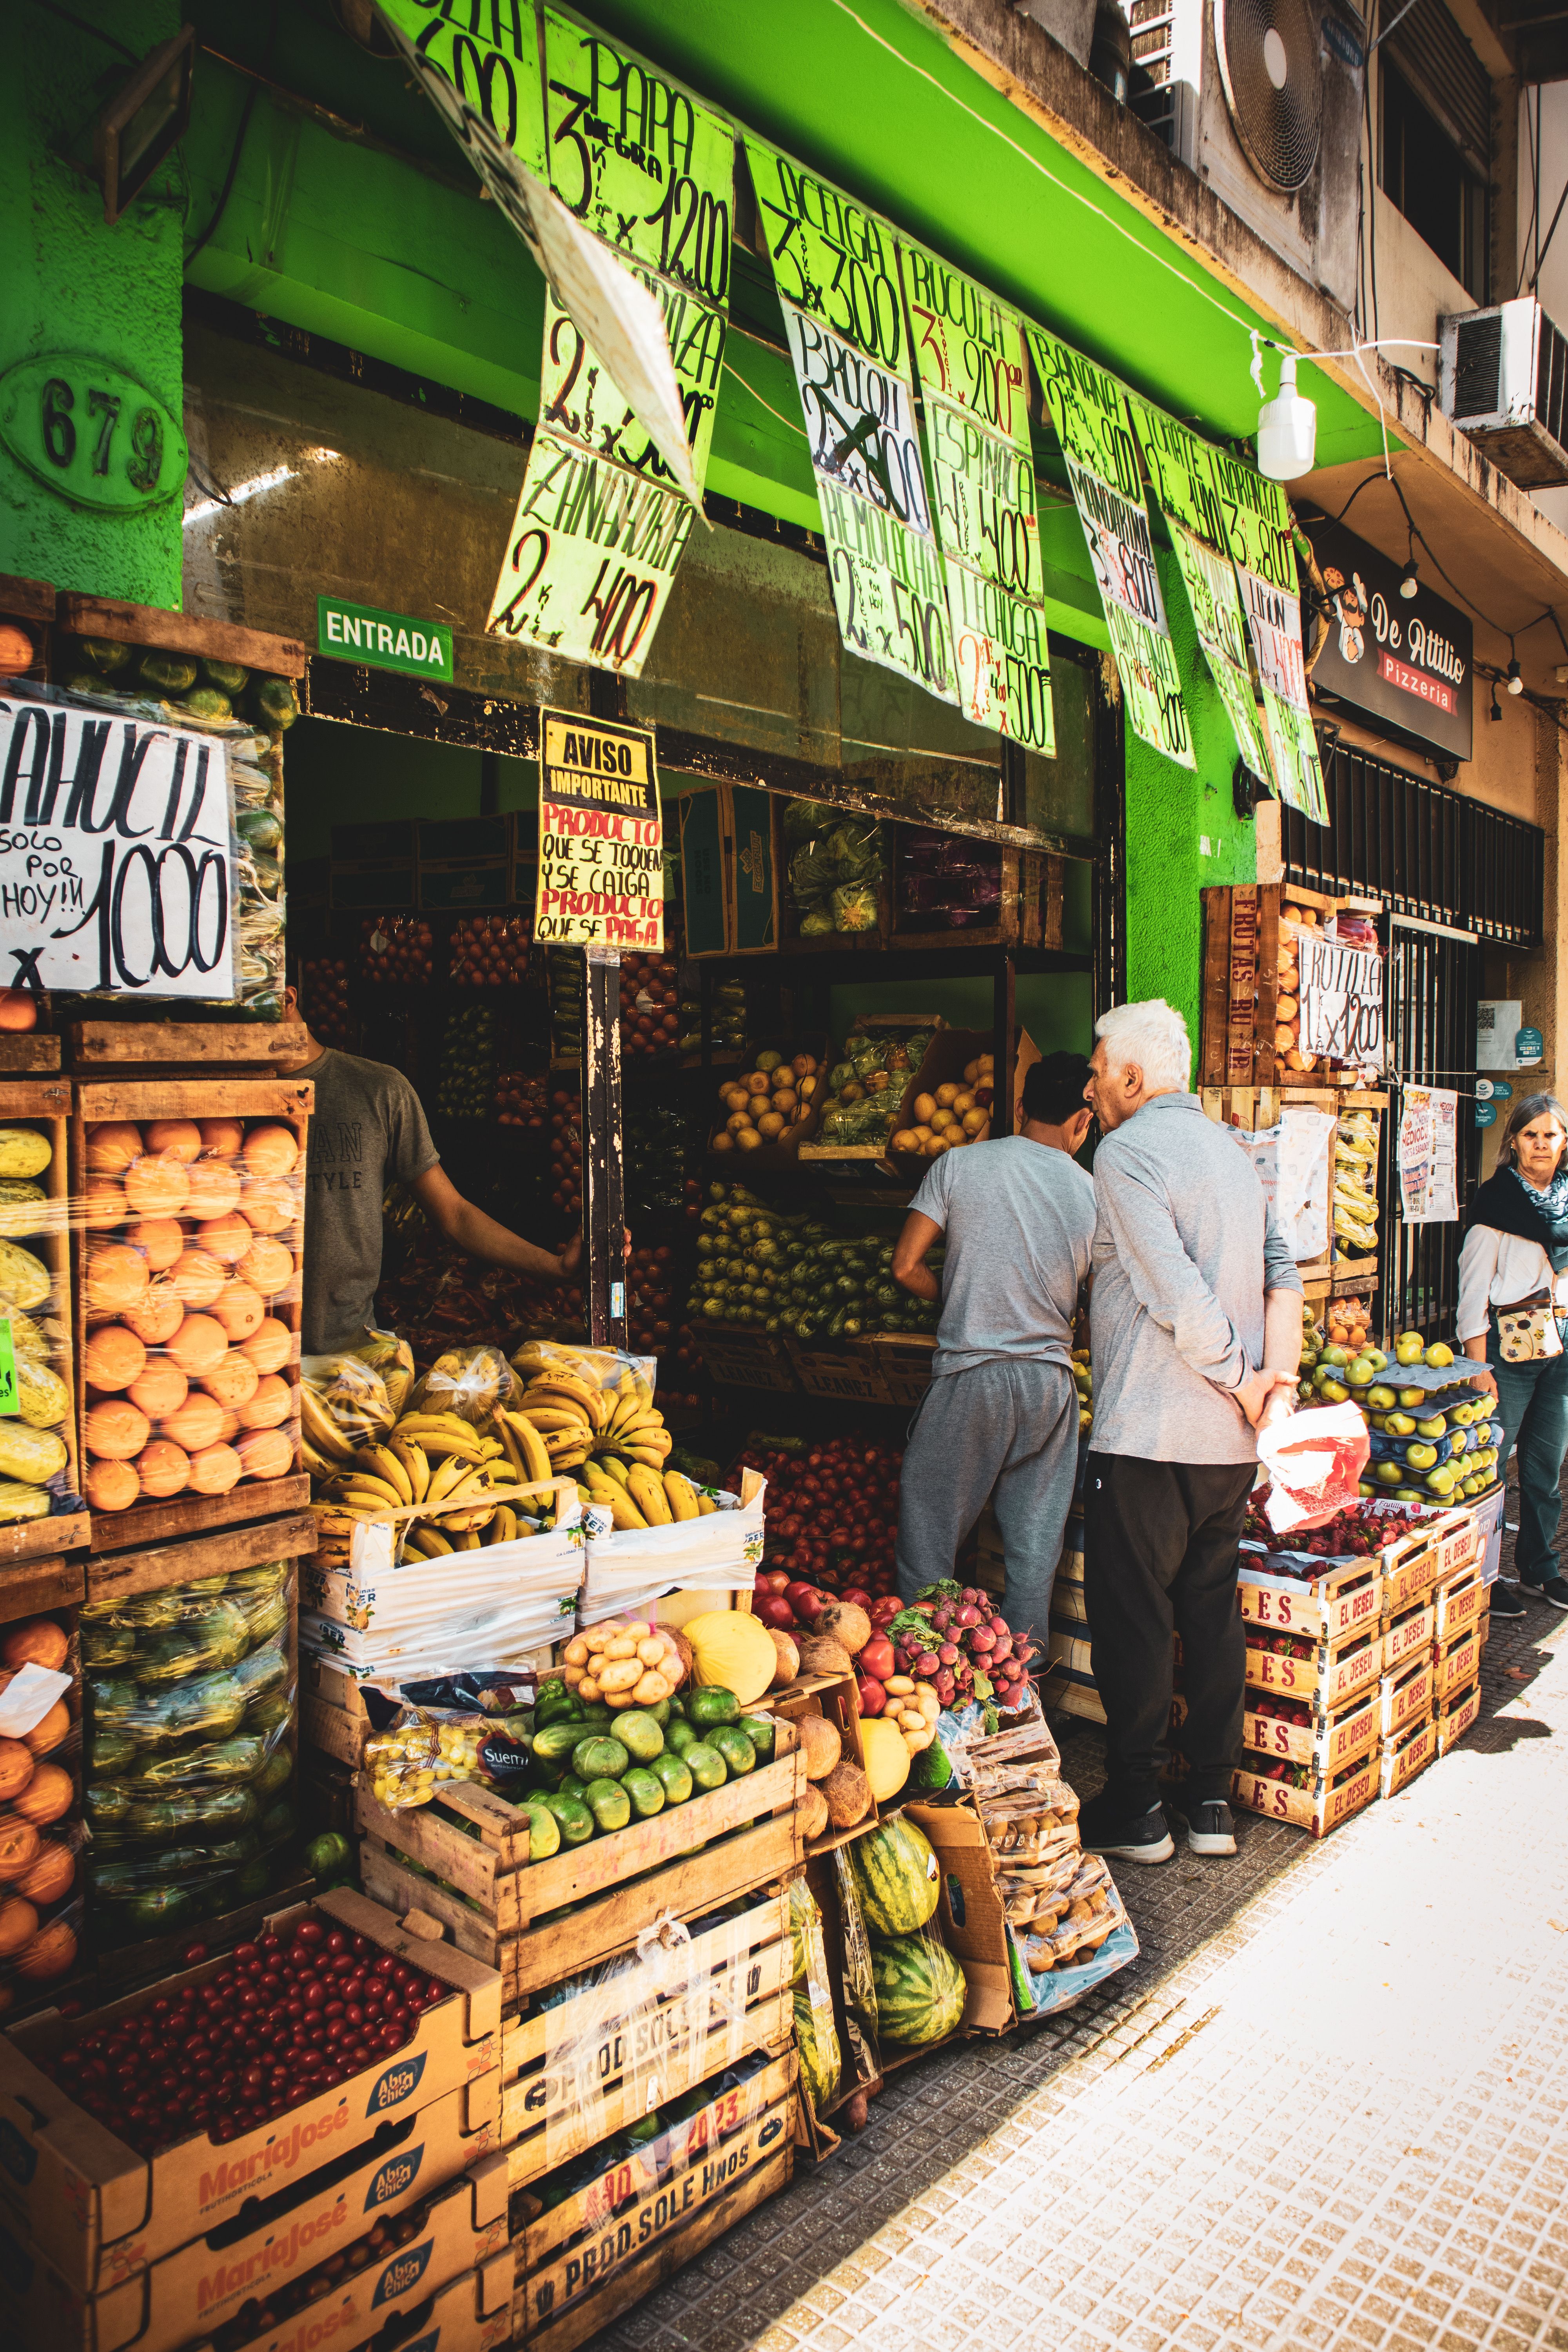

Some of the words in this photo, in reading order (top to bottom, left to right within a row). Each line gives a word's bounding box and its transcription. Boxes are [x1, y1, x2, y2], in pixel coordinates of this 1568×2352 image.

[580, 37, 695, 175] PAPA
[584, 112, 662, 184] NEGRA
[549, 79, 591, 220] 3
[644, 167, 728, 302] 1200
[776, 158, 886, 277] ACELGA
[761, 196, 808, 308] 3
[820, 234, 900, 371] 300
[909, 249, 1005, 358] RUCULA
[544, 316, 584, 435] 2
[792, 312, 900, 432] BROCOLI
[912, 304, 946, 392] 3
[1031, 331, 1120, 424] BANANA
[41, 377, 163, 492] 679
[932, 401, 1034, 515] ESPINACA
[523, 437, 699, 577] ZANAHORIA
[1068, 462, 1152, 561] MANDARINA
[1215, 453, 1280, 527] NARANJA
[821, 477, 943, 604] REMOLACHA
[978, 488, 1030, 597] 400
[1221, 496, 1247, 569] 3
[1258, 519, 1291, 590] 800
[486, 528, 550, 636] 2
[580, 558, 657, 669] 400
[869, 593, 883, 615] HOY
[959, 567, 1042, 666] LECHUGA
[1118, 541, 1158, 624] 800
[1249, 578, 1285, 634] LIMON
[326, 610, 445, 666] ENTRADA
[833, 548, 867, 650] 2
[891, 574, 947, 692] 500
[1104, 595, 1175, 686] MANZANA
[1371, 592, 1401, 648] De
[1408, 618, 1465, 684] Attilio
[958, 634, 982, 721] 2
[1005, 652, 1047, 748] 500
[1155, 673, 1187, 755] 800
[1386, 658, 1449, 708] Pizzeria
[0, 701, 226, 847] AHUCIL
[550, 769, 648, 808] IMPORTANTE
[563, 731, 632, 777] AVISO
[0, 829, 62, 853] SOLO
[543, 802, 661, 847] PRODUCTO
[543, 834, 573, 860] QUE
[579, 839, 605, 864] SE
[609, 842, 663, 874] TOQUEN
[26, 854, 79, 879] POR
[542, 863, 553, 890] Y
[556, 864, 579, 891] SE
[50, 839, 228, 992] 1000
[537, 916, 576, 941] QUE
[579, 919, 603, 944] SE
[605, 915, 659, 947] PAGA
[541, 888, 664, 919] PRODUCTO
[1232, 898, 1256, 983] FRUTAS
[1300, 939, 1382, 997] FRUTILLA
[587, 1510, 608, 1528] ananas
[1379, 1500, 1407, 1510] Frutillas
[1400, 1575, 1409, 1598] EL
[1411, 1560, 1431, 1590] DESEO
[1444, 1547, 1452, 1568] EL
[1454, 1534, 1472, 1561] DESEO
[1340, 1604, 1349, 1627] EL
[1352, 1588, 1374, 1621] DESEO
[1392, 1633, 1401, 1656] EL
[1404, 1616, 1426, 1647] DESEO
[1450, 1604, 1456, 1624] EL
[1459, 1591, 1475, 1617] DESEO
[1338, 1668, 1347, 1691] EL
[1350, 1650, 1373, 1682] DESEO
[1398, 1696, 1406, 1719] EL
[1408, 1677, 1426, 1708] DESEO
[1447, 1660, 1454, 1681] EL
[1457, 1644, 1474, 1674] DESEO
[1338, 1730, 1347, 1755] EL
[1350, 1711, 1373, 1746] DESEO
[1399, 1755, 1406, 1776] EL
[1409, 1733, 1428, 1764] DESEO
[1449, 1717, 1456, 1738] EL
[1457, 1700, 1474, 1728] DESEO
[1334, 1793, 1343, 1817] EL
[1347, 1773, 1370, 1808] DESEO
[199, 2171, 273, 2216] FRUTIHORTICOLA
[566, 2174, 695, 2298] PROD.SOLE
